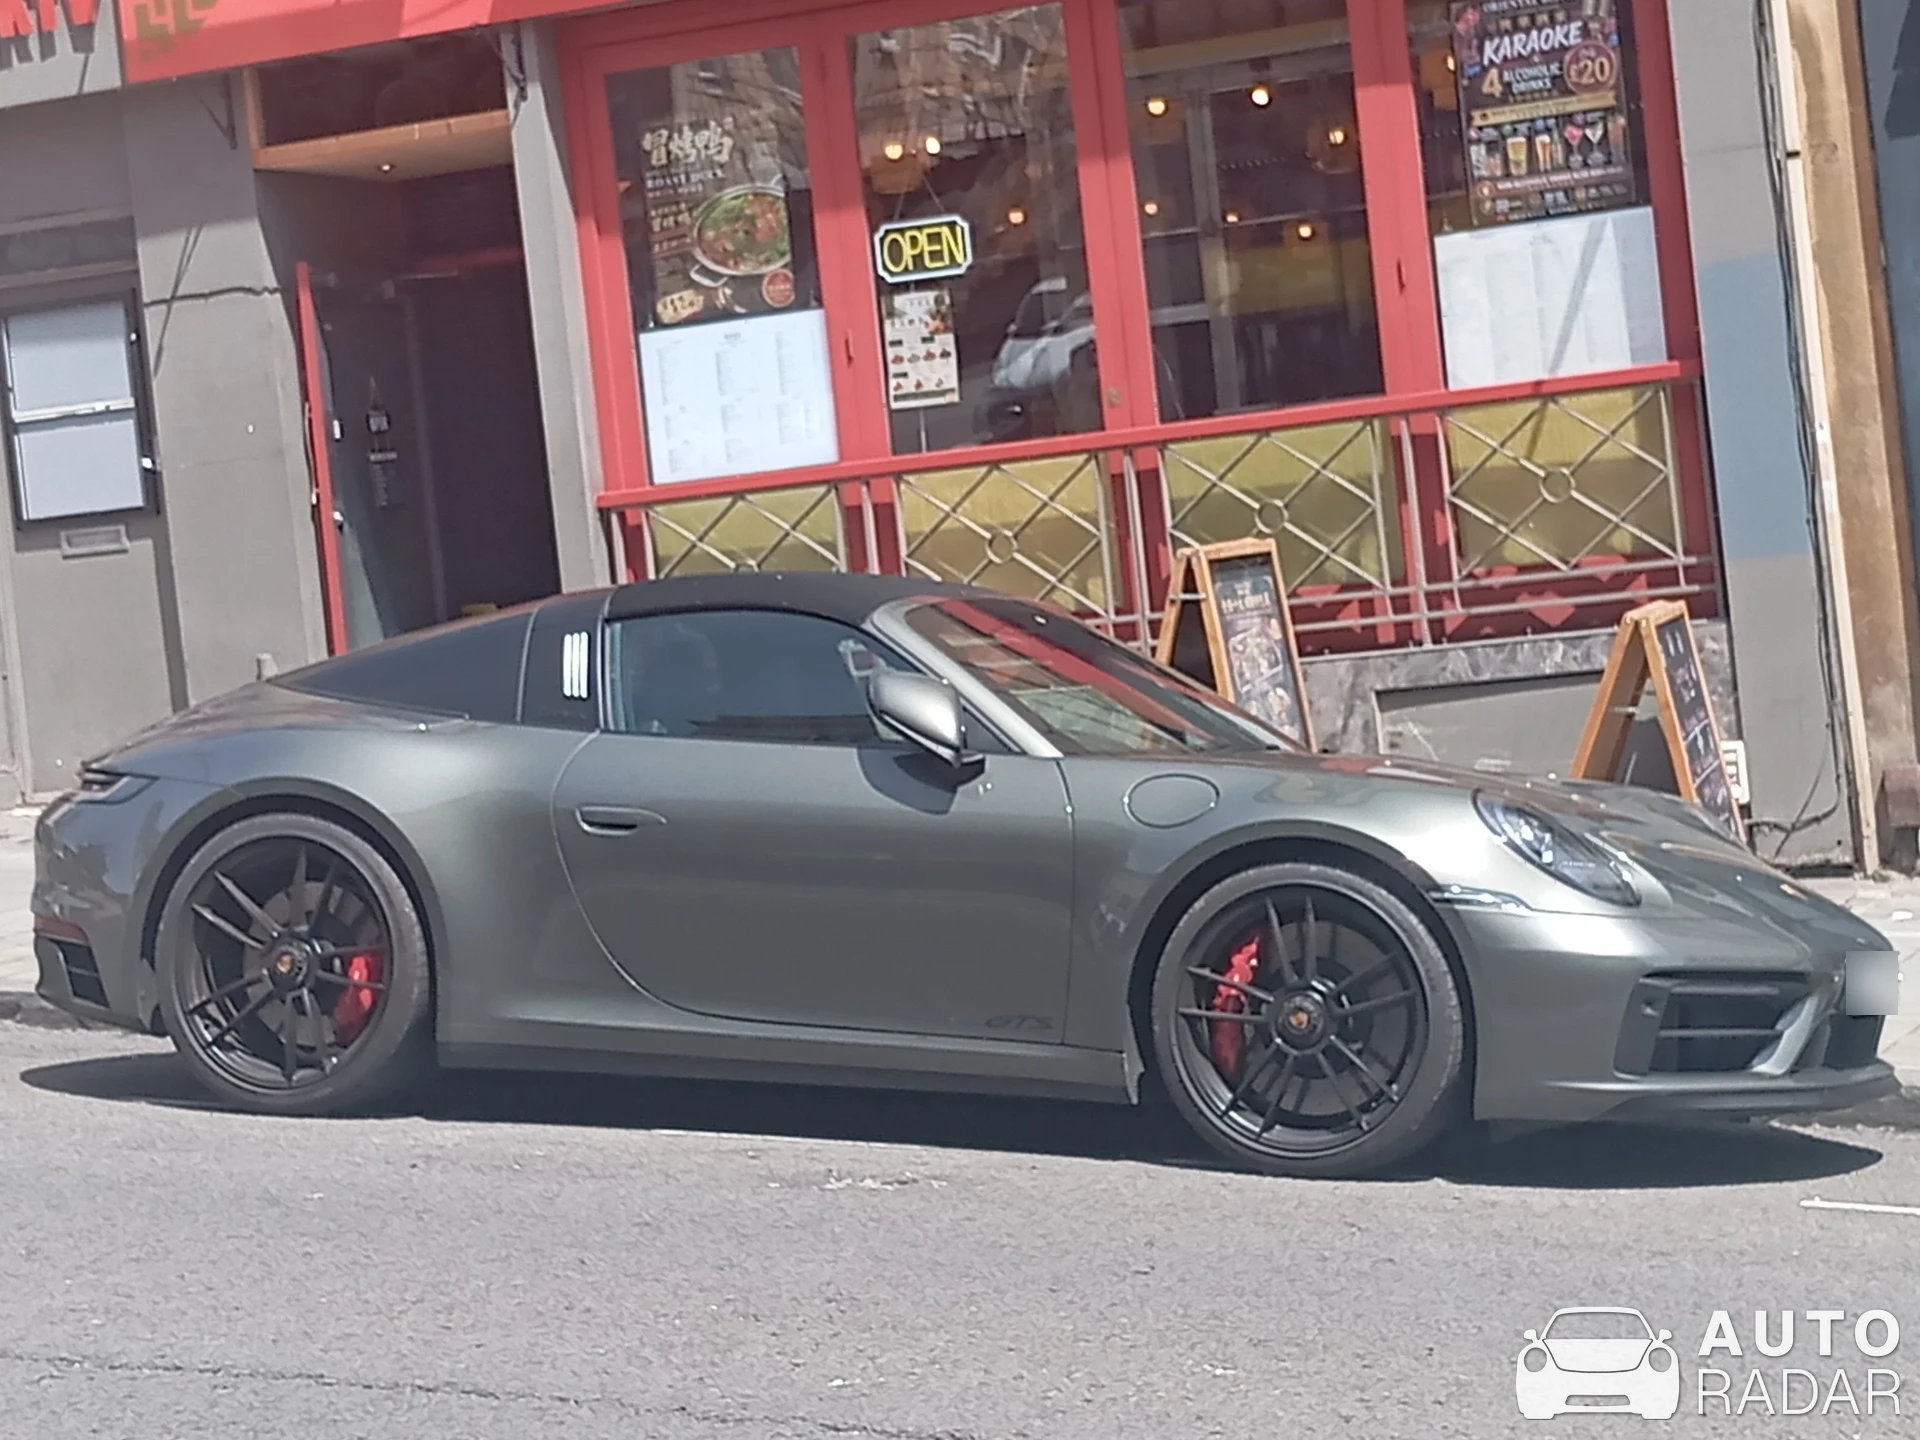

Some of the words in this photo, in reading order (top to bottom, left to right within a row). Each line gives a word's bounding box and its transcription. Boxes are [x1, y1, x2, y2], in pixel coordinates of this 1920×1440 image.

[1483, 21, 1583, 66] KARAOKE
[1481, 67, 1503, 98] 4
[1570, 57, 1610, 85] £20
[882, 225, 966, 273] OPEN
[984, 1014, 1054, 1030] GTS
